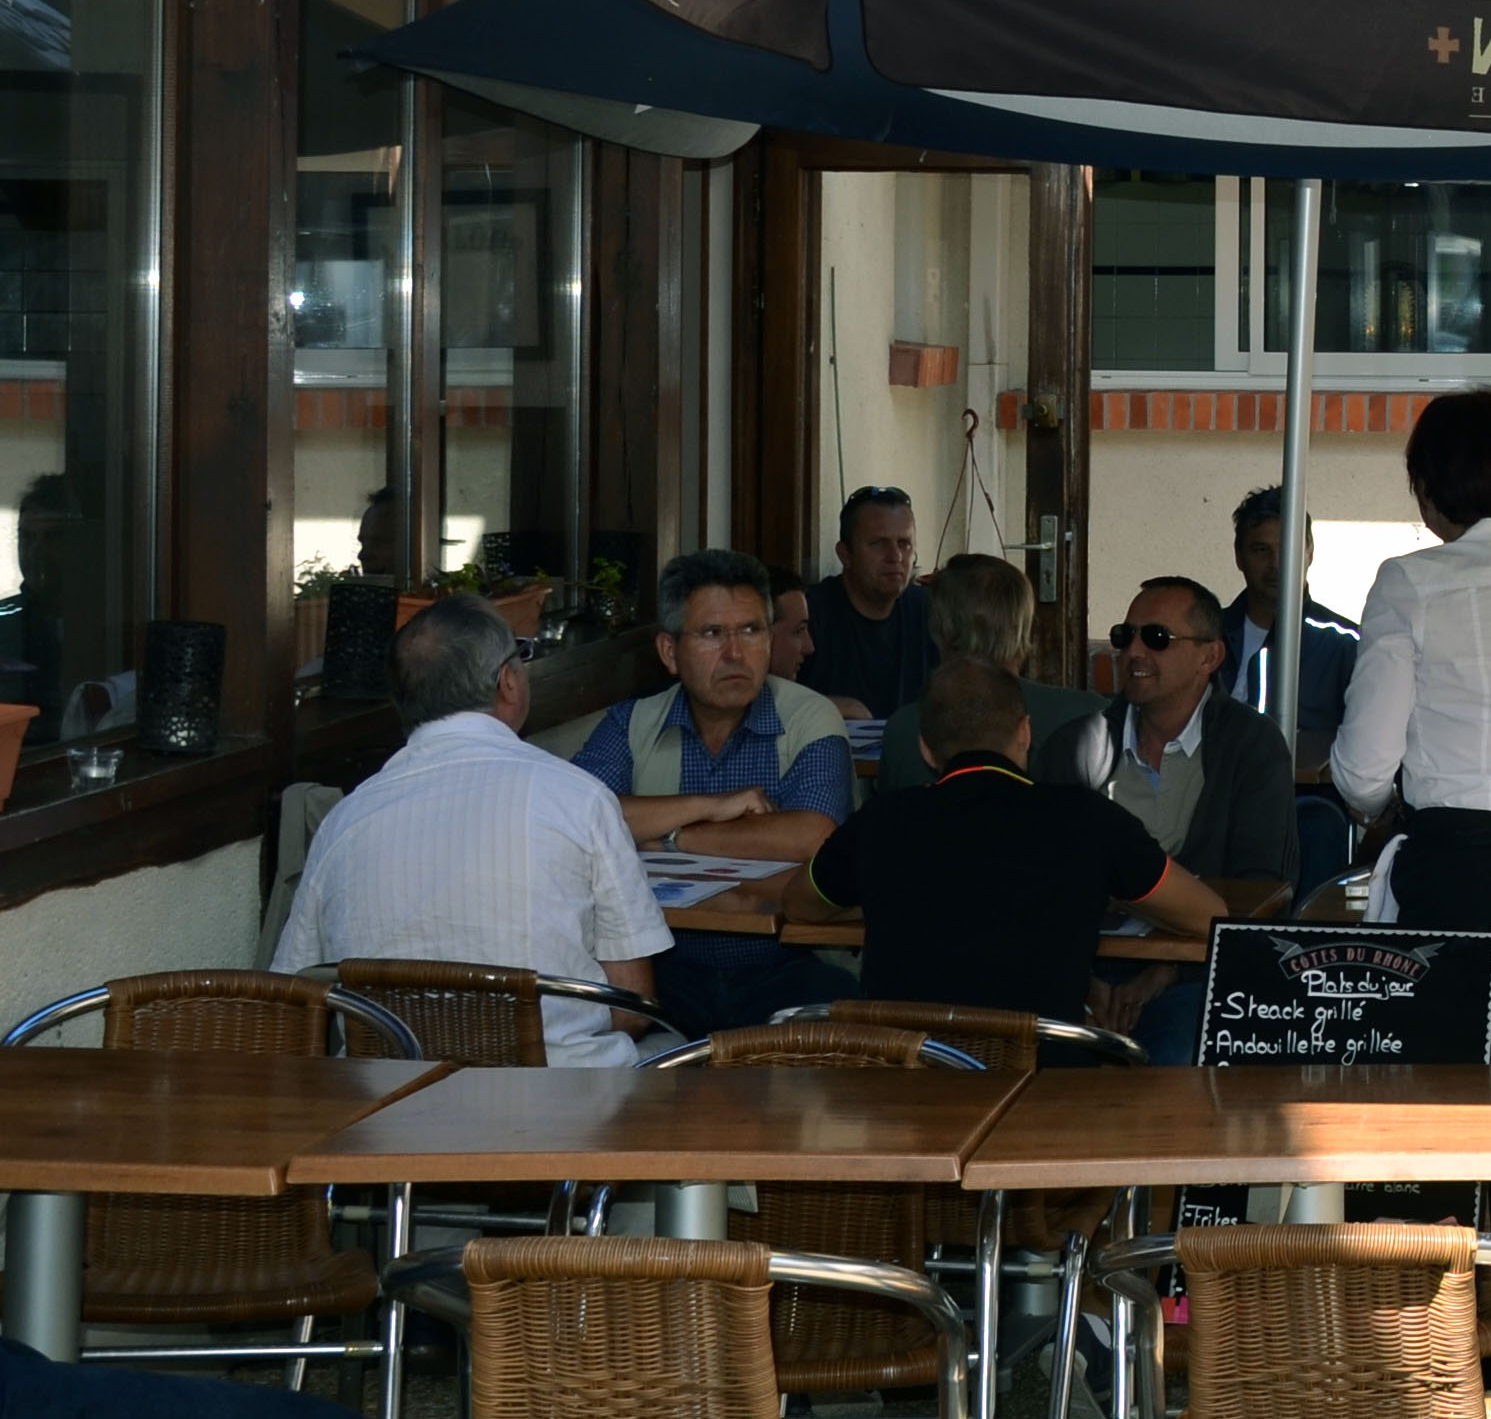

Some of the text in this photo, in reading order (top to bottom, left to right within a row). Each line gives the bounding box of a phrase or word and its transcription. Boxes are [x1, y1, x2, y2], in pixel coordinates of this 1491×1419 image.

[1346, 947, 1366, 962] DU
[1301, 969, 1414, 1001] Plats du jour
[1311, 999, 1366, 1036] grillé
[1341, 1028, 1403, 1066] grillée
